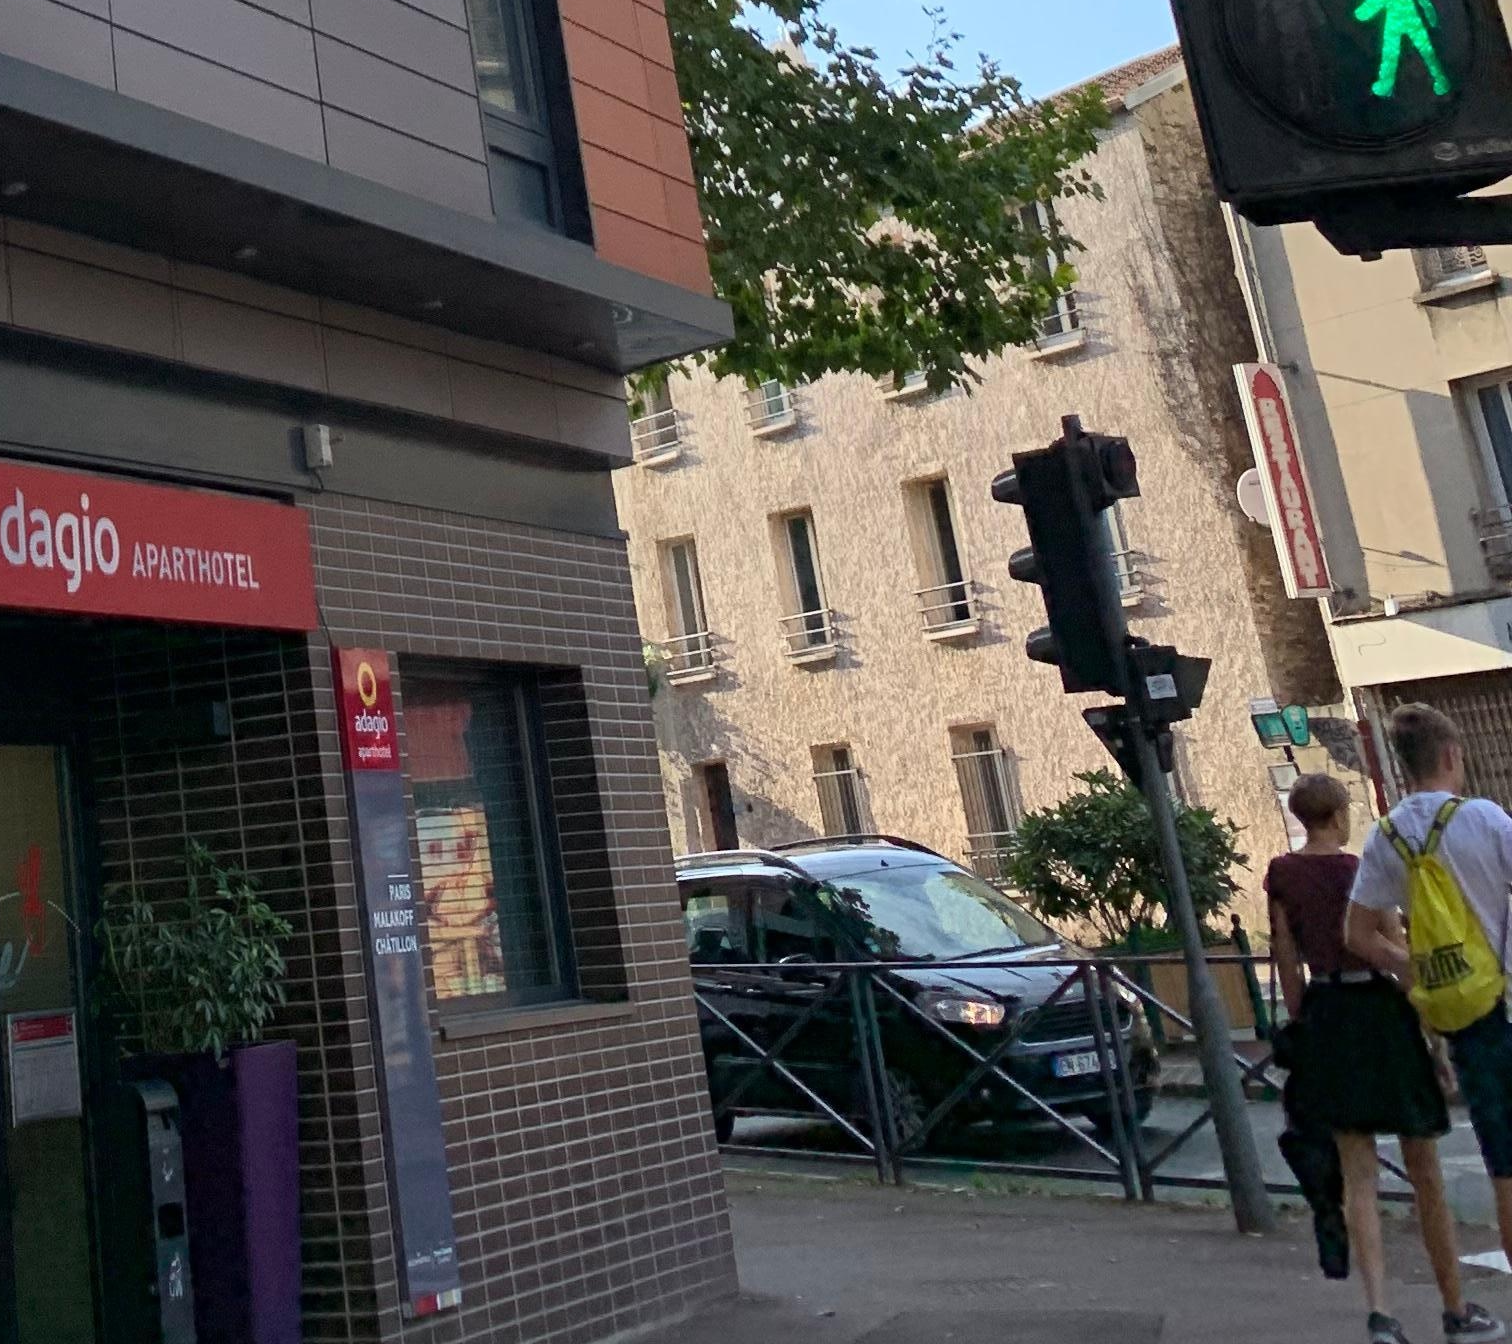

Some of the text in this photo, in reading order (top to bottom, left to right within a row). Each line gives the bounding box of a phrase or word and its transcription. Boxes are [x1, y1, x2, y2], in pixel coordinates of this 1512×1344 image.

[132, 540, 260, 590] APARTHOTEL
[354, 708, 389, 739] adagio
[388, 884, 412, 901] PARIS
[373, 909, 414, 928] MALAKOFF
